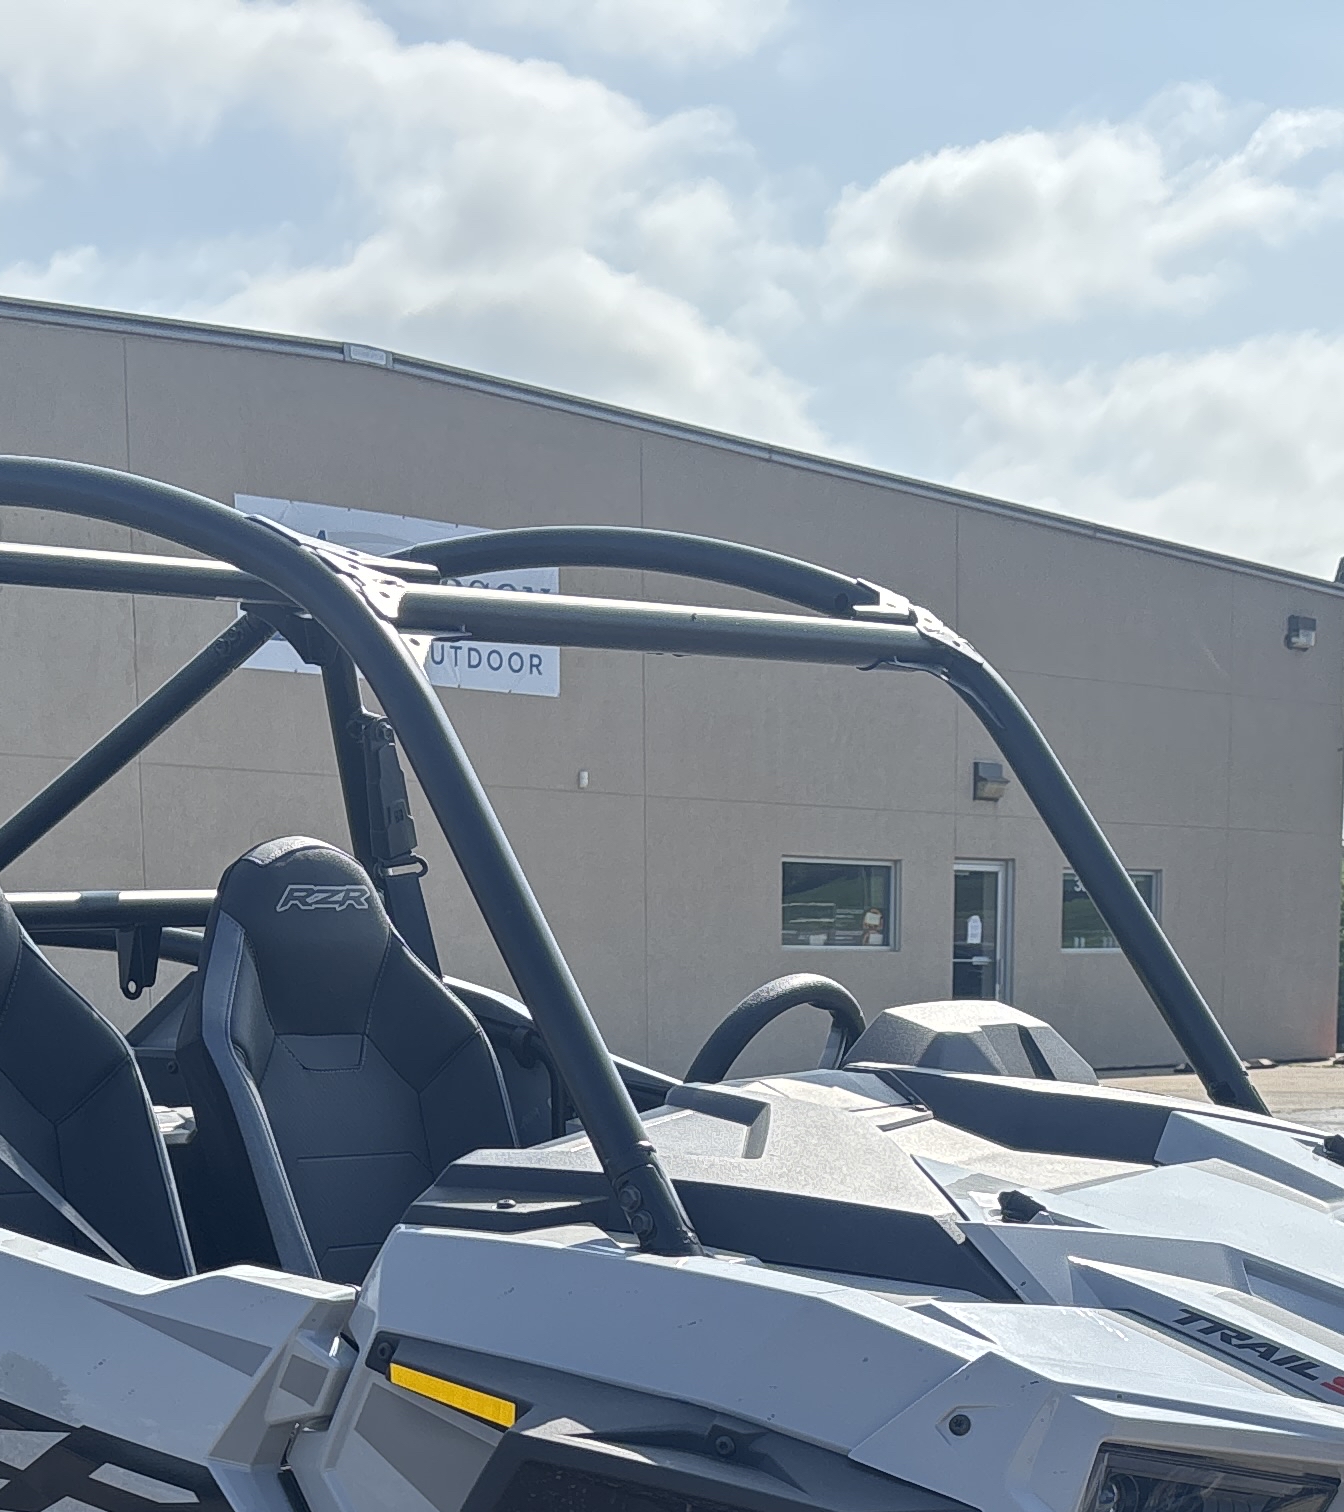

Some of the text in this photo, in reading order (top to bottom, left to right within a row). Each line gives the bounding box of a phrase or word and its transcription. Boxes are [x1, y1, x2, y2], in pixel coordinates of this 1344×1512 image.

[430, 643, 543, 676] UTDOOR
[276, 884, 371, 912] RZR
[1172, 1308, 1322, 1381] TRAIL
